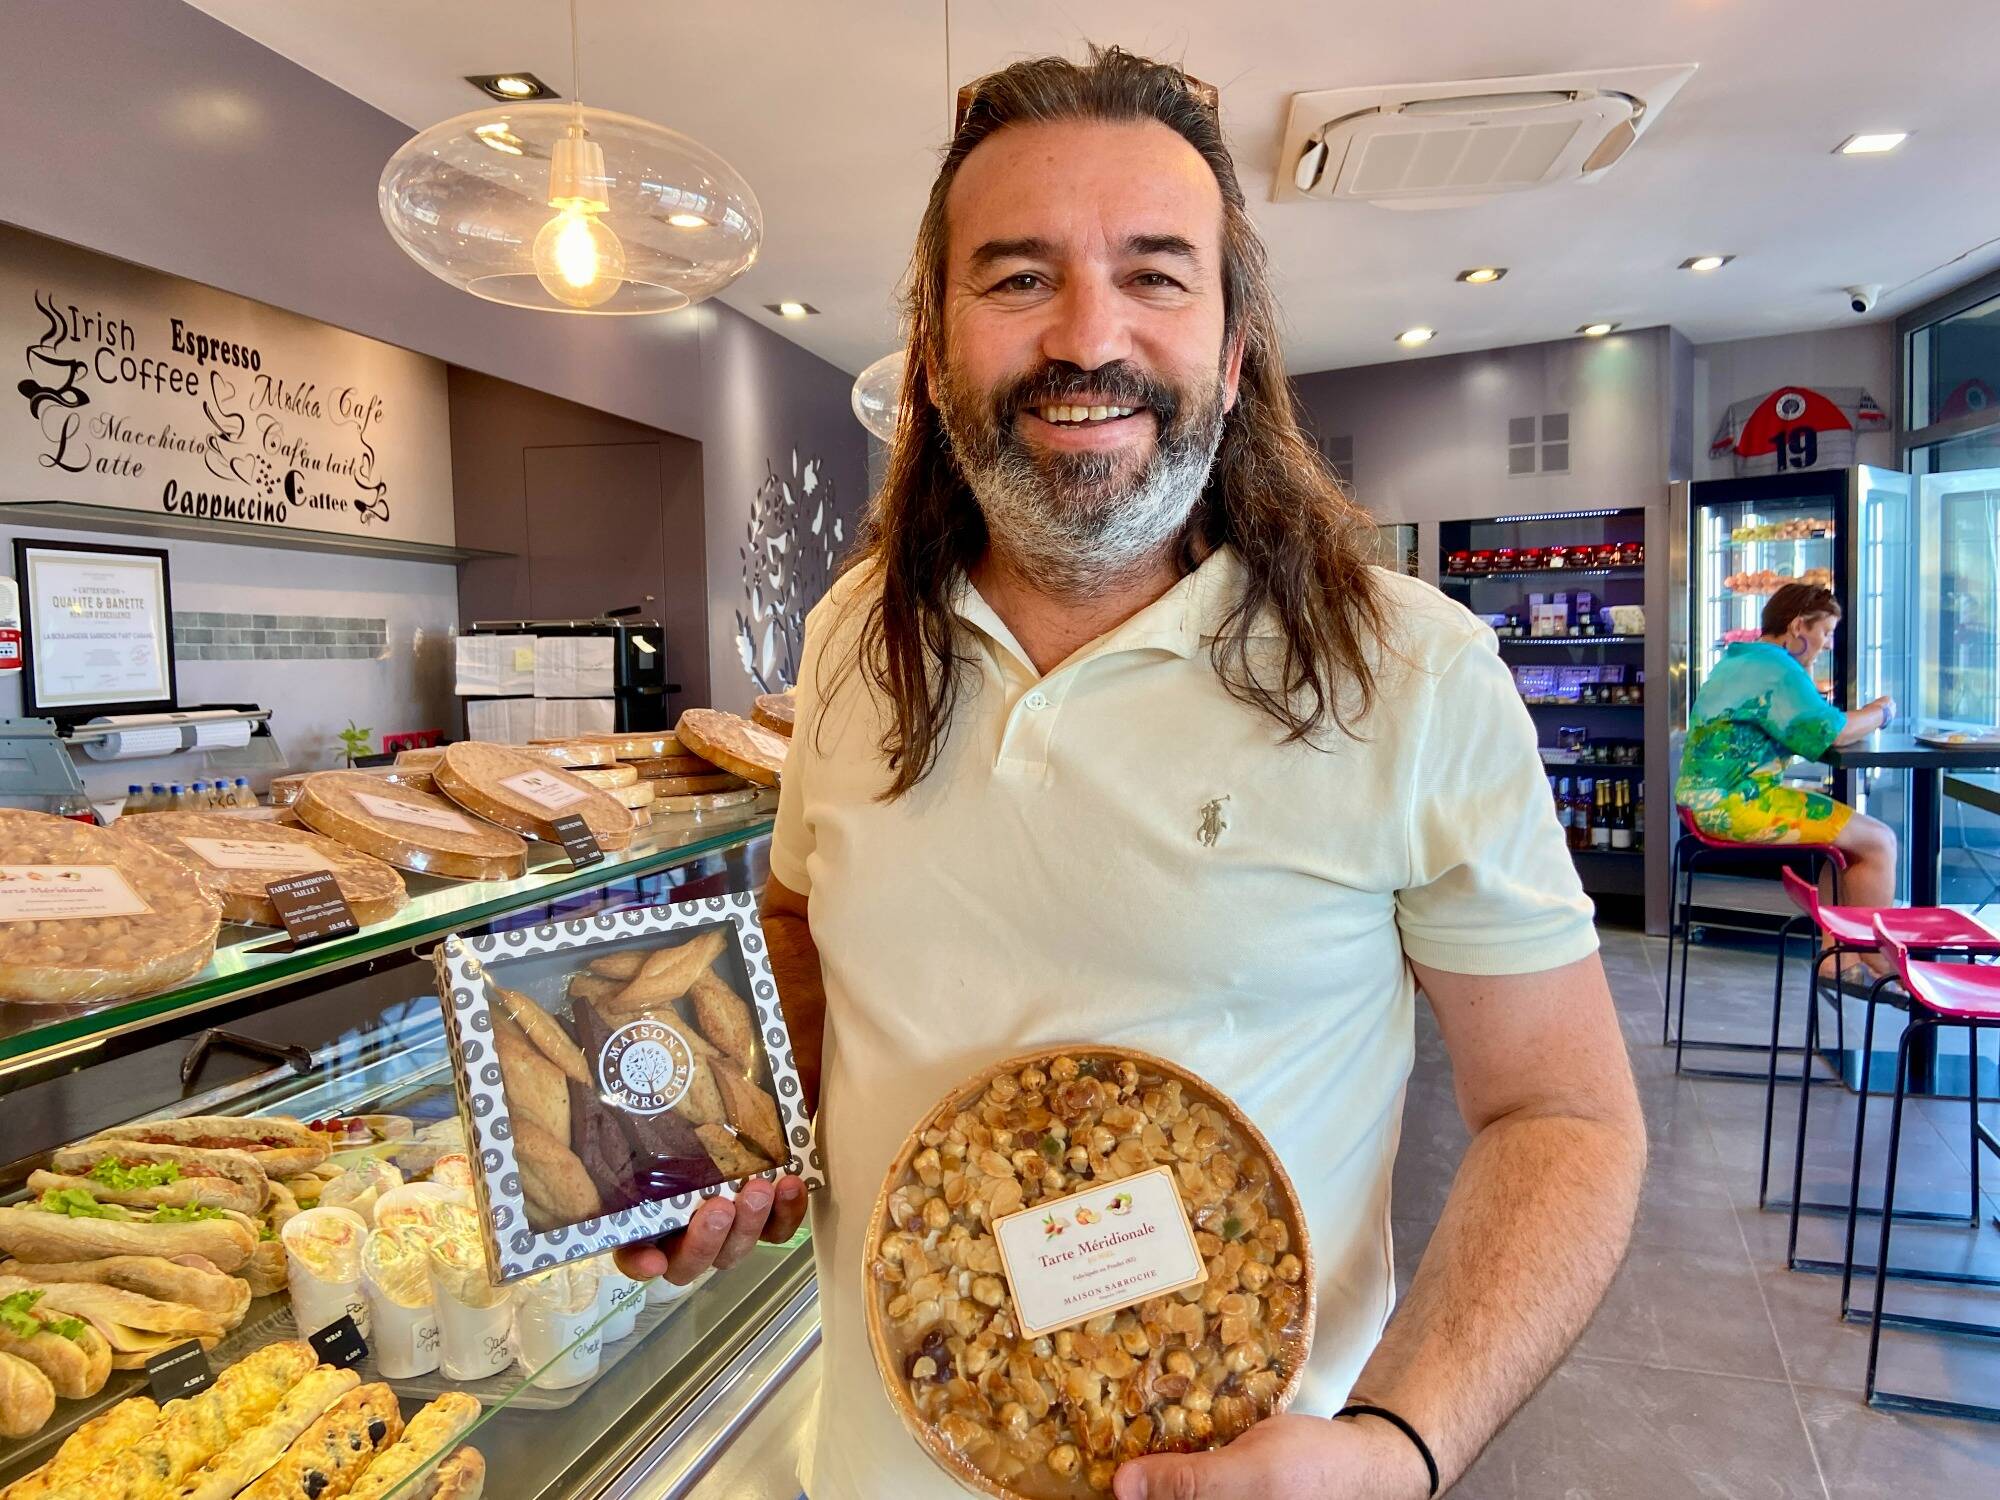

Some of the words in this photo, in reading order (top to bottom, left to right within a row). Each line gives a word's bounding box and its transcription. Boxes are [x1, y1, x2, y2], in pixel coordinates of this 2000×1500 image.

[68, 305, 135, 351] Irish
[170, 318, 261, 372] Espresso
[95, 346, 199, 396] Coffee
[89, 411, 205, 454] Macchiato
[328, 386, 384, 433] Café
[38, 404, 145, 477] Latte
[256, 413, 308, 467] Café
[300, 456, 321, 469] au
[326, 452, 356, 476] lait
[1770, 426, 1818, 472] 19
[163, 479, 287, 523] Cappuccino
[270, 884, 293, 895] TARTE
[608, 1025, 679, 1061] MAISON
[610, 1065, 688, 1108] SARROCHE
[1038, 1251, 1075, 1268] Tarte
[1077, 1222, 1156, 1256] Méridionale
[1064, 1288, 1102, 1305] MAISON
[1105, 1269, 1158, 1291] SARROCHE
[325, 1330, 342, 1343] WRAP
